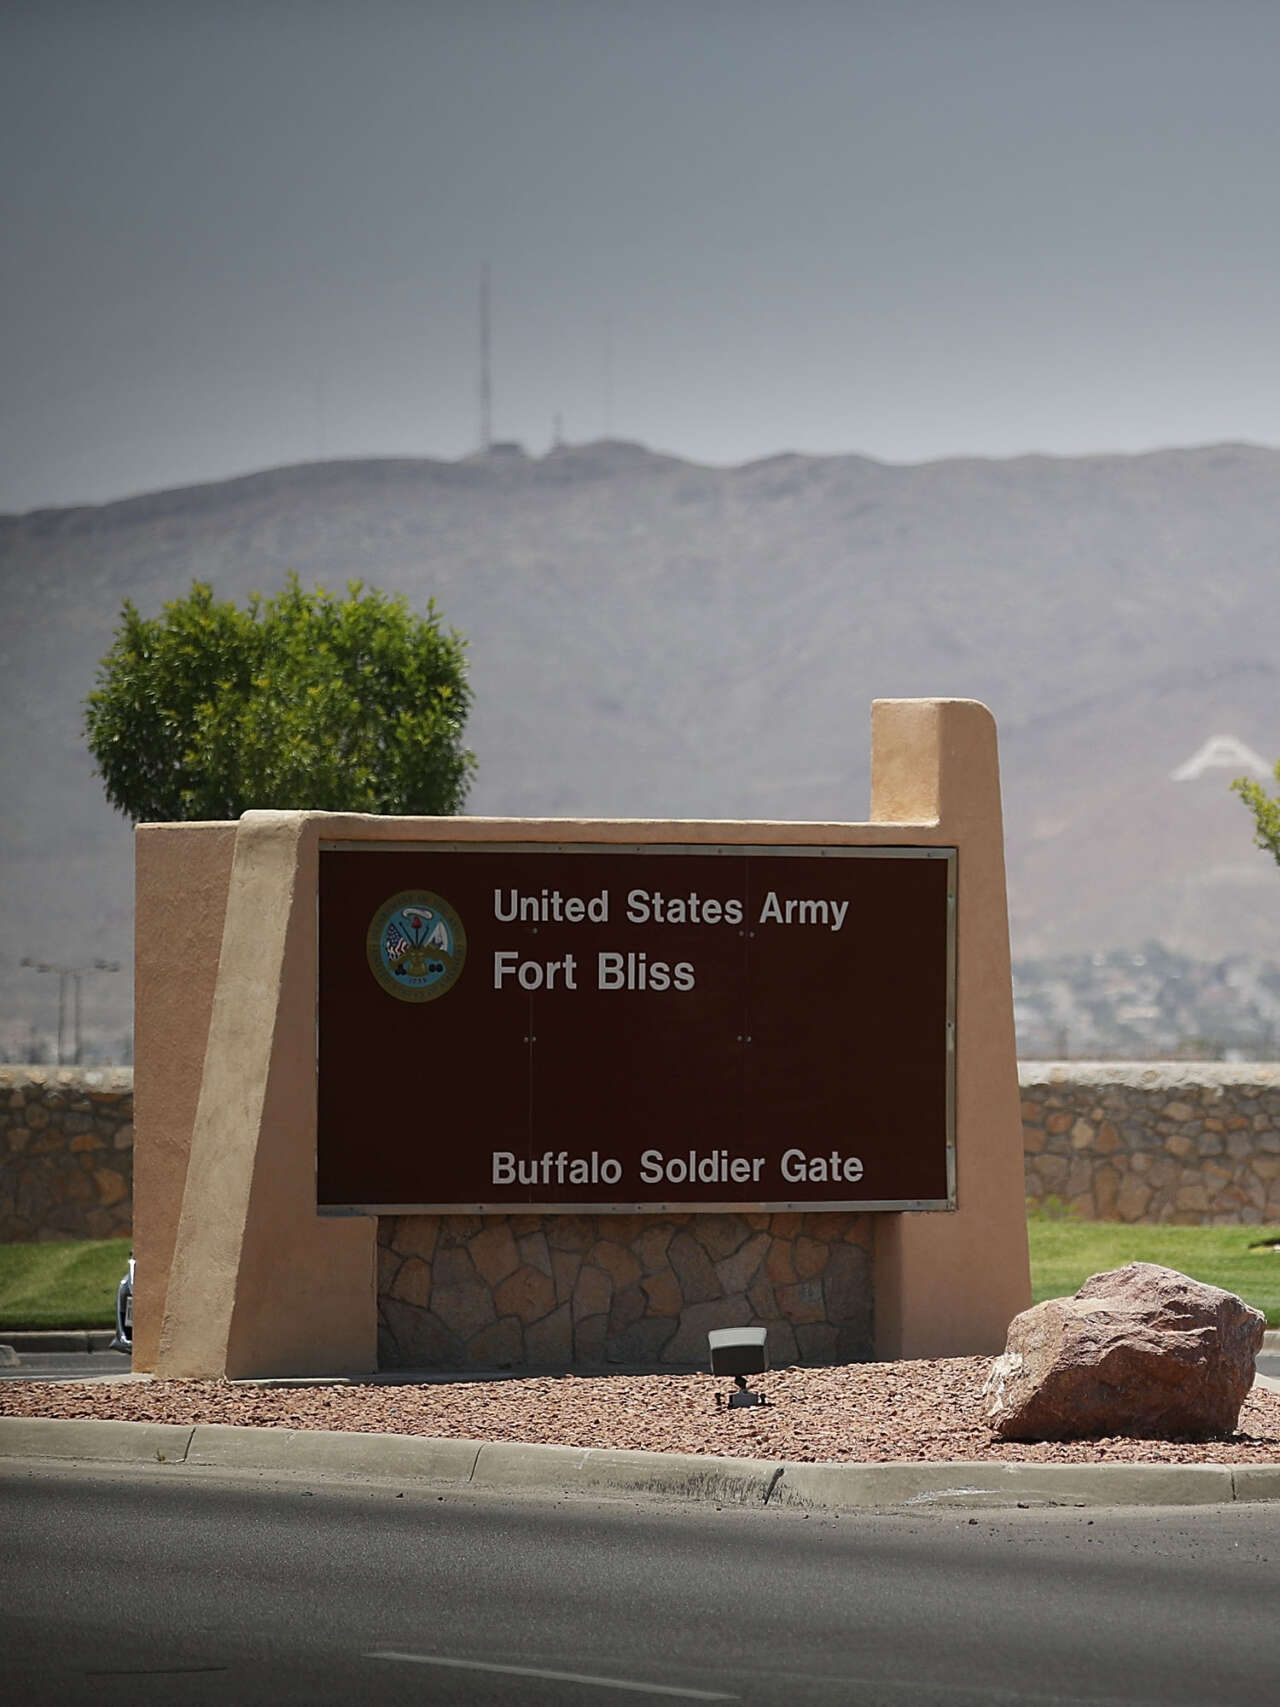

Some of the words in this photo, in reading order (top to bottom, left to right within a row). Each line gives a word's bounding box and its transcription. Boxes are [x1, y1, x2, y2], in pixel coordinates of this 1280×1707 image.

[495, 889, 609, 923] United
[627, 890, 742, 925] States
[759, 892, 848, 932] Army
[494, 951, 577, 990] Fort
[598, 952, 695, 991] Bliss
[492, 1151, 622, 1185] Buffalo
[639, 1149, 766, 1184] Soldier
[780, 1148, 864, 1183] Gate
